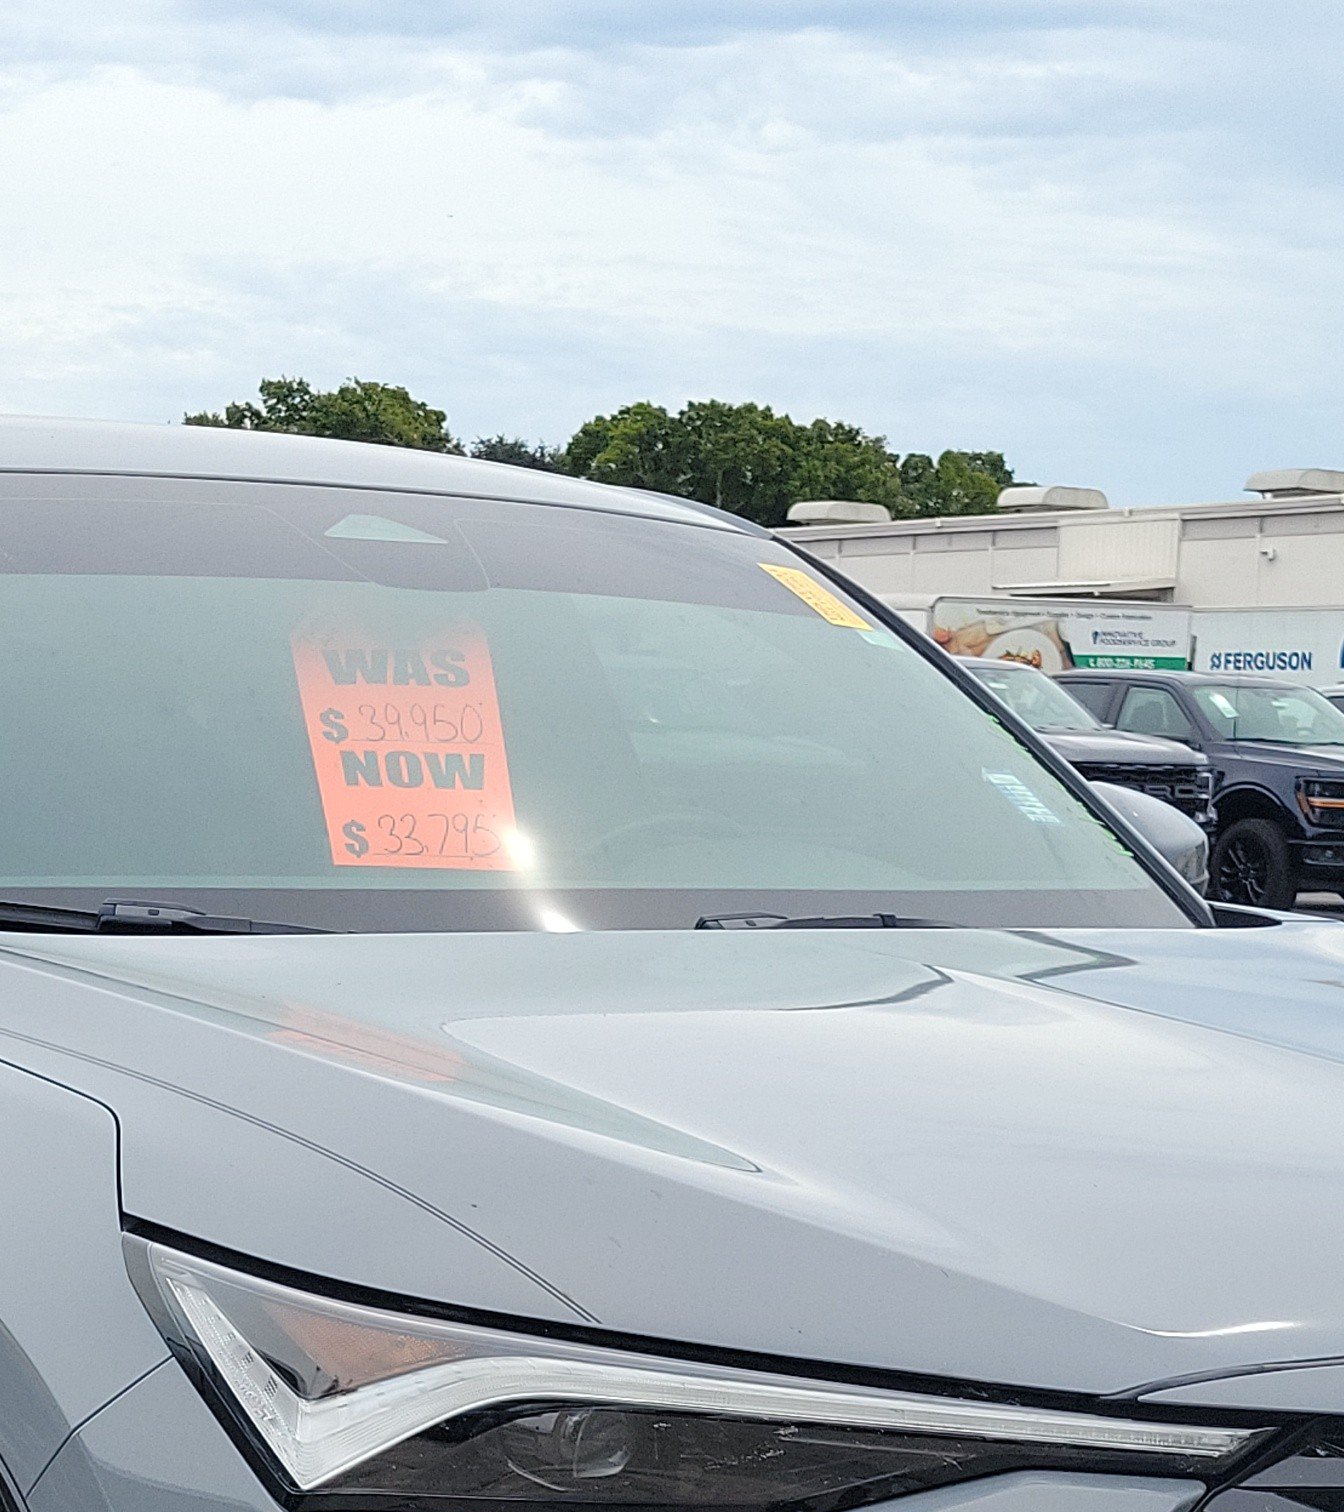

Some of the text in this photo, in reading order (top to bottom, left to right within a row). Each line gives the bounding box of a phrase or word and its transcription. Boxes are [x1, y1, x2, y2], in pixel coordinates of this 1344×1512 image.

[322, 649, 470, 687] WAS
[1224, 651, 1312, 670] FERGUSON
[319, 707, 349, 743] $
[340, 751, 485, 789] NOW
[342, 819, 369, 857] $
